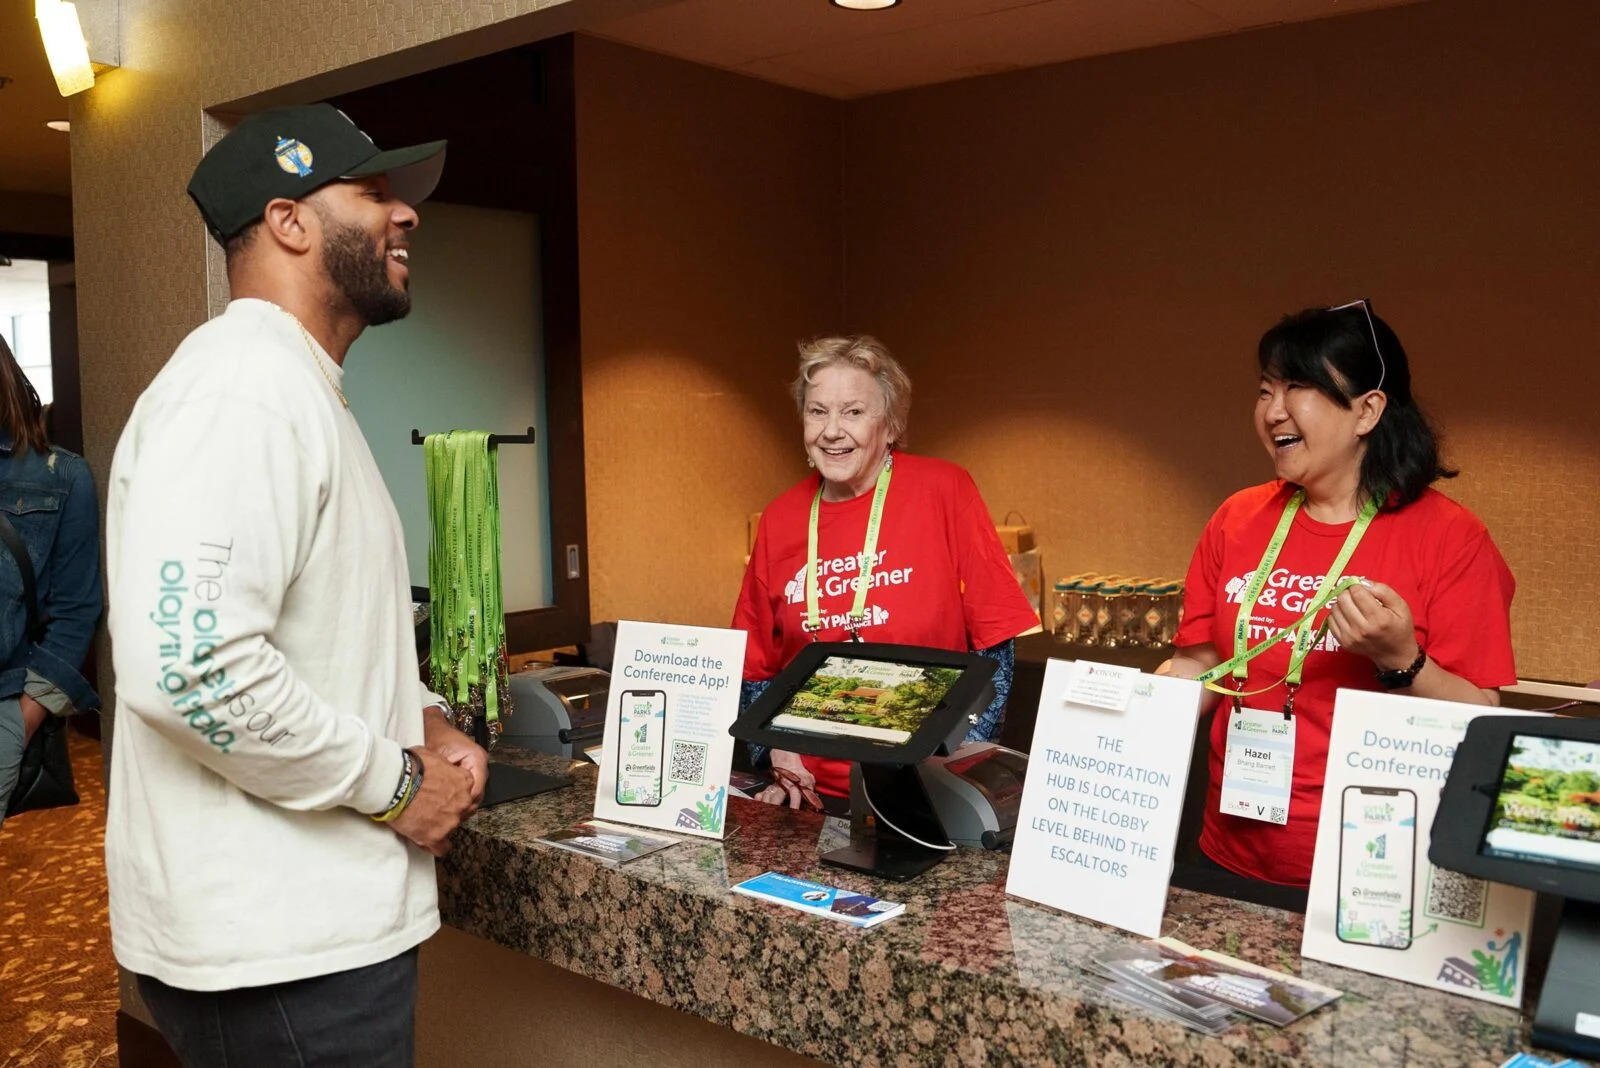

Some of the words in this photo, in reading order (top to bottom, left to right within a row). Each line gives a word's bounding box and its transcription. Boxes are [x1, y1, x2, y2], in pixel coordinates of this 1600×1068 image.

[817, 549, 887, 577] Greater
[825, 567, 913, 597] Greener
[1268, 568, 1365, 591] Grea
[1257, 588, 1277, 608] &
[802, 616, 831, 632] CY
[831, 608, 872, 628] PARS
[1247, 624, 1276, 641] ITY
[194, 537, 233, 602] The
[246, 710, 297, 746] our
[1299, 630, 1308, 651] PARKS
[634, 649, 698, 668] Download
[702, 656, 723, 670] the
[623, 665, 696, 685] Conference
[699, 673, 729, 690] App!
[1097, 735, 1124, 753] THE
[1244, 747, 1271, 760] Hazel
[1363, 730, 1457, 759] Downloa
[632, 763, 656, 771] Greenfields
[1045, 749, 1171, 787] TRANSPORTATION
[1346, 751, 1451, 781] Conferenc
[1046, 772, 1075, 791] HUB
[1078, 780, 1090, 795] IS
[1093, 783, 1159, 811] LOCATED
[1048, 797, 1068, 814] ON
[1072, 802, 1098, 821] THE
[1101, 808, 1149, 833] LOBBY
[1257, 805, 1265, 816] V
[1032, 816, 1069, 838] LEVEL
[1073, 828, 1125, 853] BEHIND
[1131, 841, 1159, 862] THE
[1050, 845, 1128, 879] ESCALTORS
